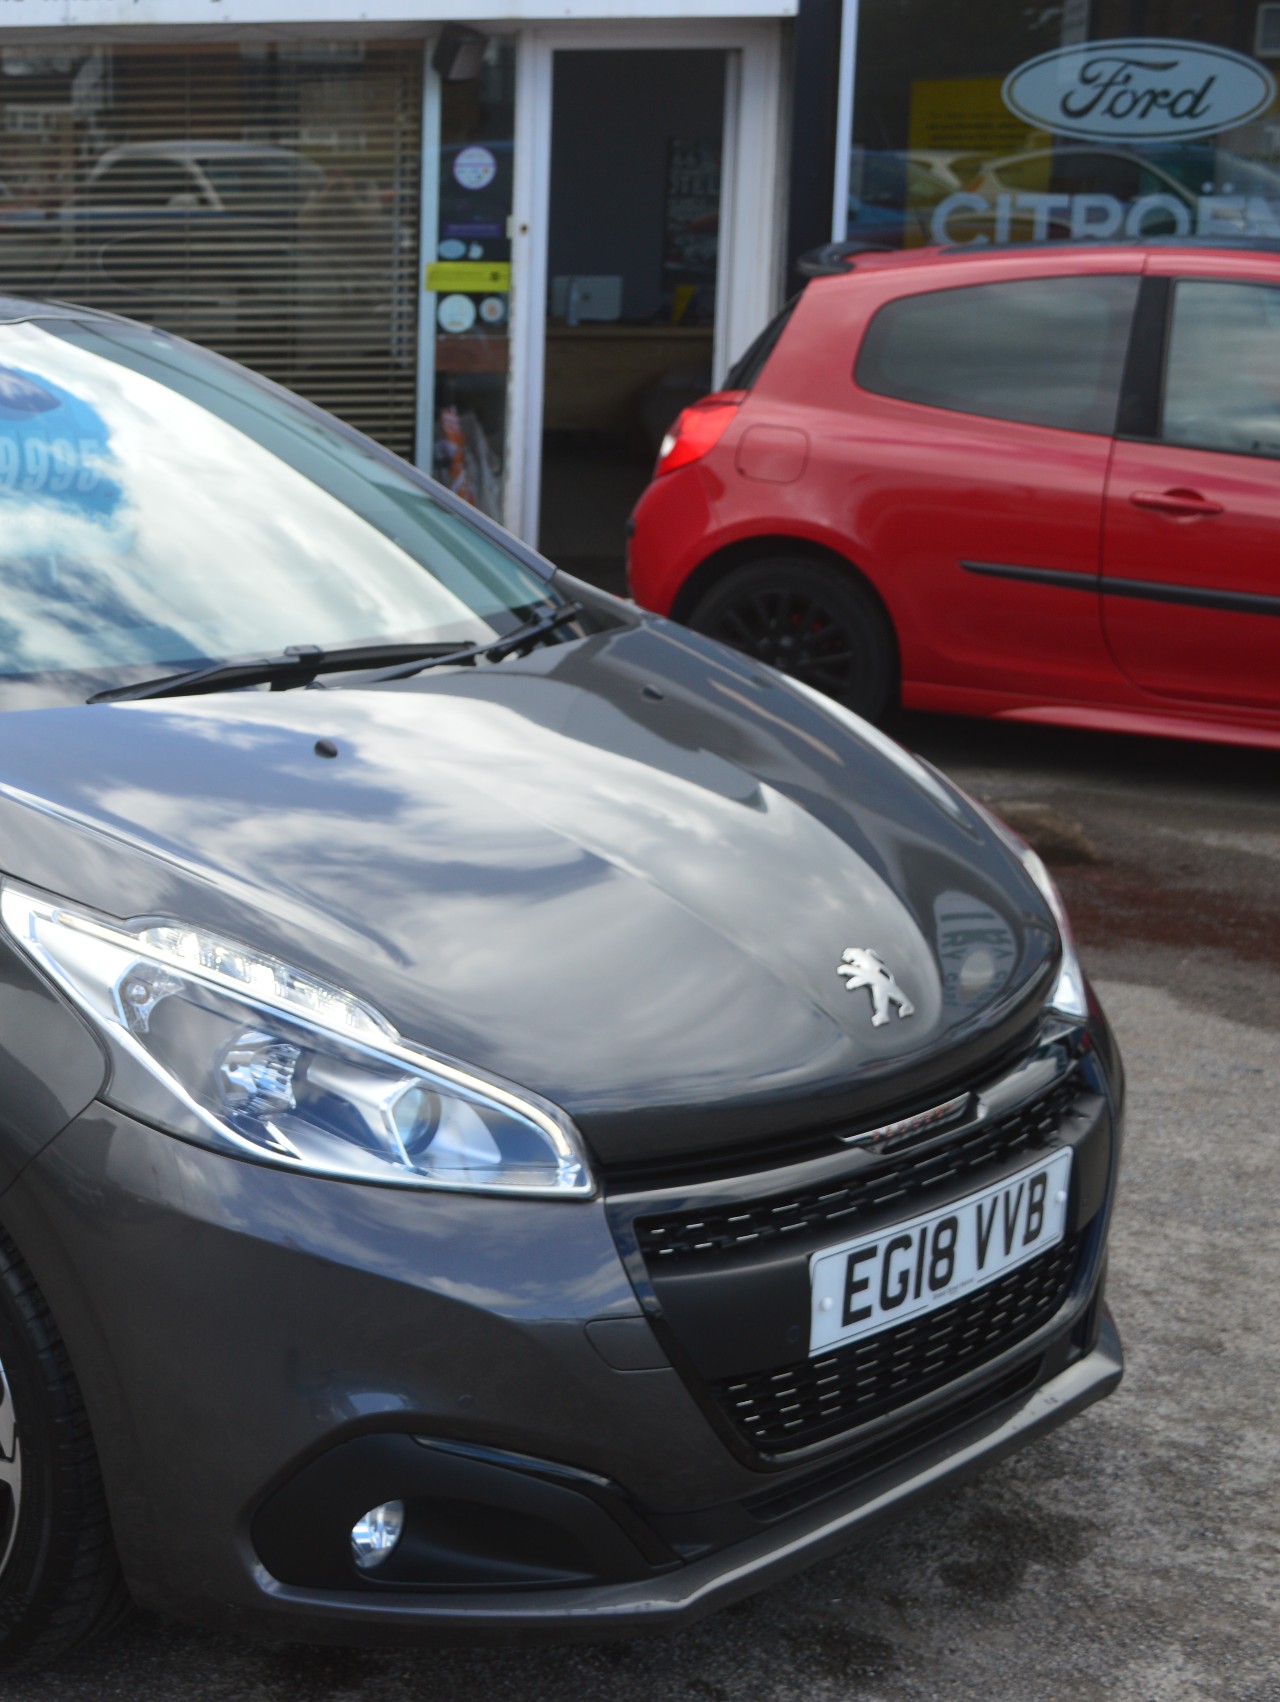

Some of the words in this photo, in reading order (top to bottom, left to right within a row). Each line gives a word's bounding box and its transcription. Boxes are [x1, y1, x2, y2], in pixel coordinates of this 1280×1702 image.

[1060, 57, 1217, 120] Ford
[841, 1215, 959, 1328] EG18
[976, 1171, 1048, 1271] VVB
